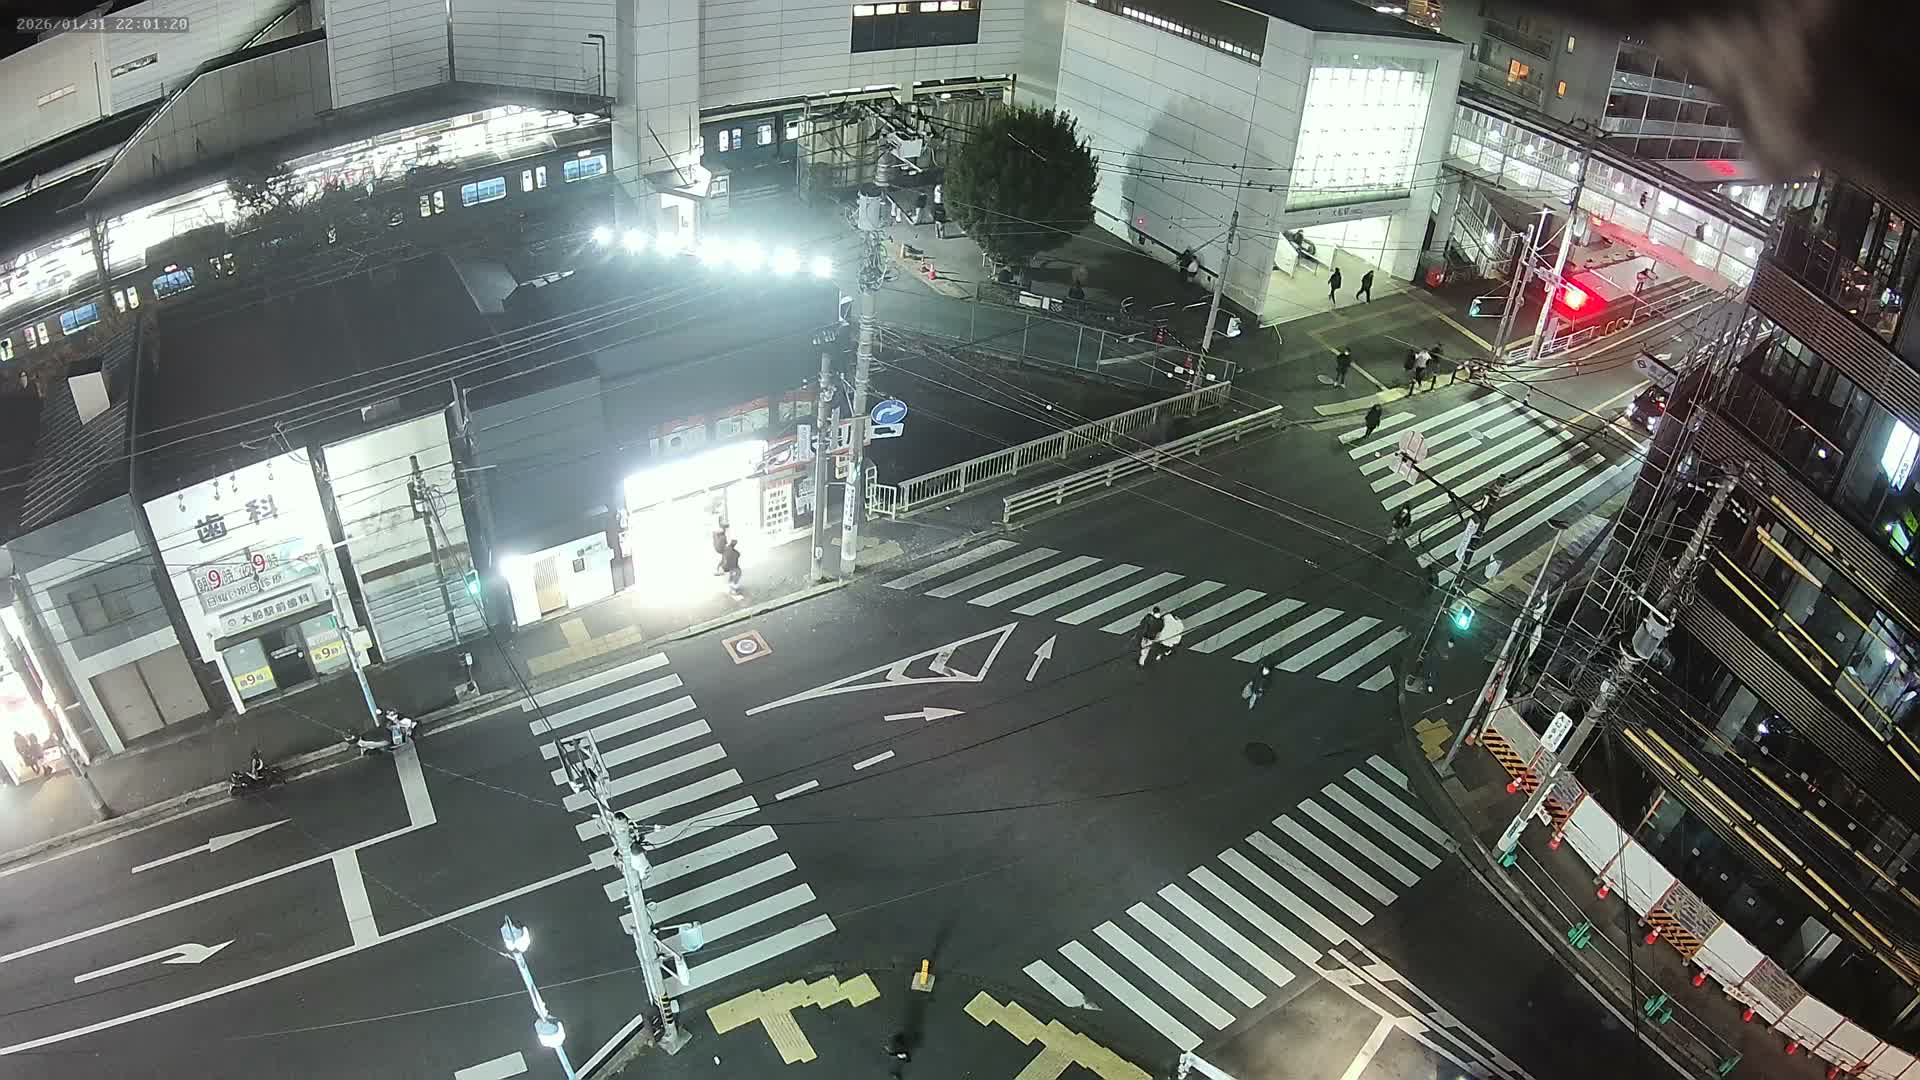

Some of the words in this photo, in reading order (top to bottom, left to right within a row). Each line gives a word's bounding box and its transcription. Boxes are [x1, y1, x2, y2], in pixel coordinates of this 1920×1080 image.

[195, 494, 279, 543] 歯科
[242, 593, 311, 625] 大船駅前歯科
